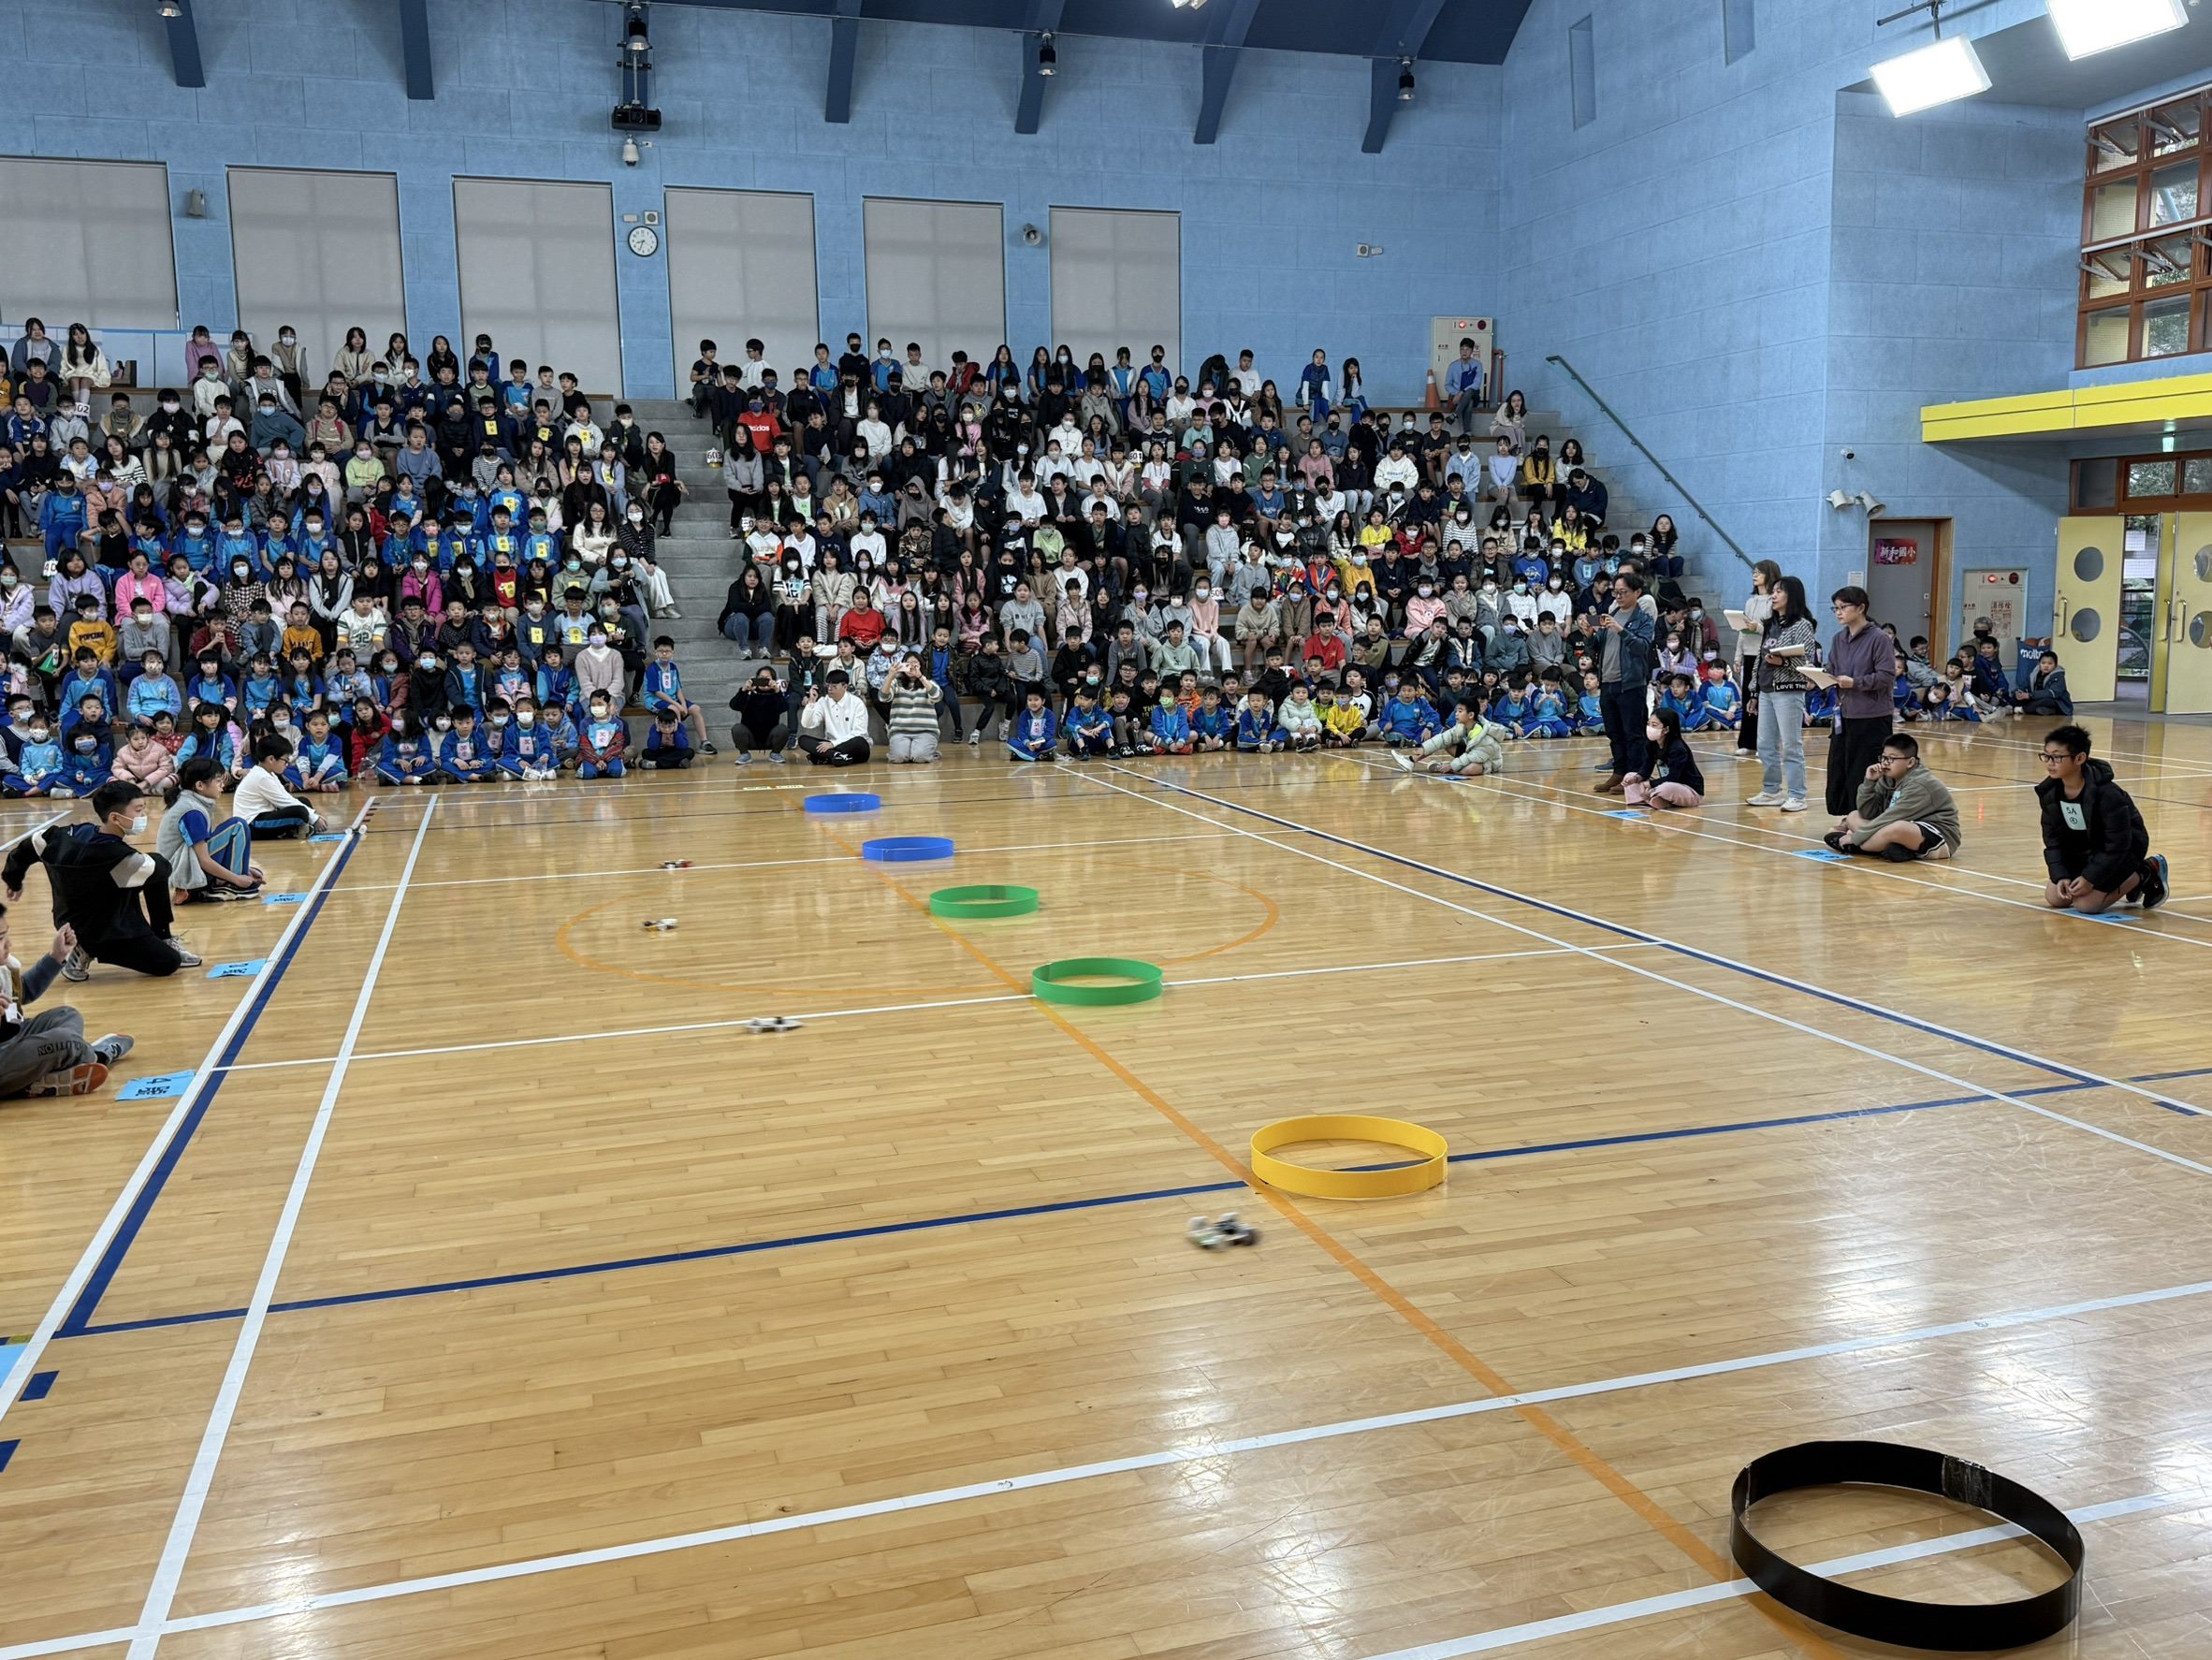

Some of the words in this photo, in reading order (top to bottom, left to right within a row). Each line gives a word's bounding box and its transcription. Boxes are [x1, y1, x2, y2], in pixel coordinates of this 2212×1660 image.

[1880, 546, 1916, 558] 新和國小
[2020, 648, 2047, 660] molt
[2066, 807, 2077, 815] 5A
